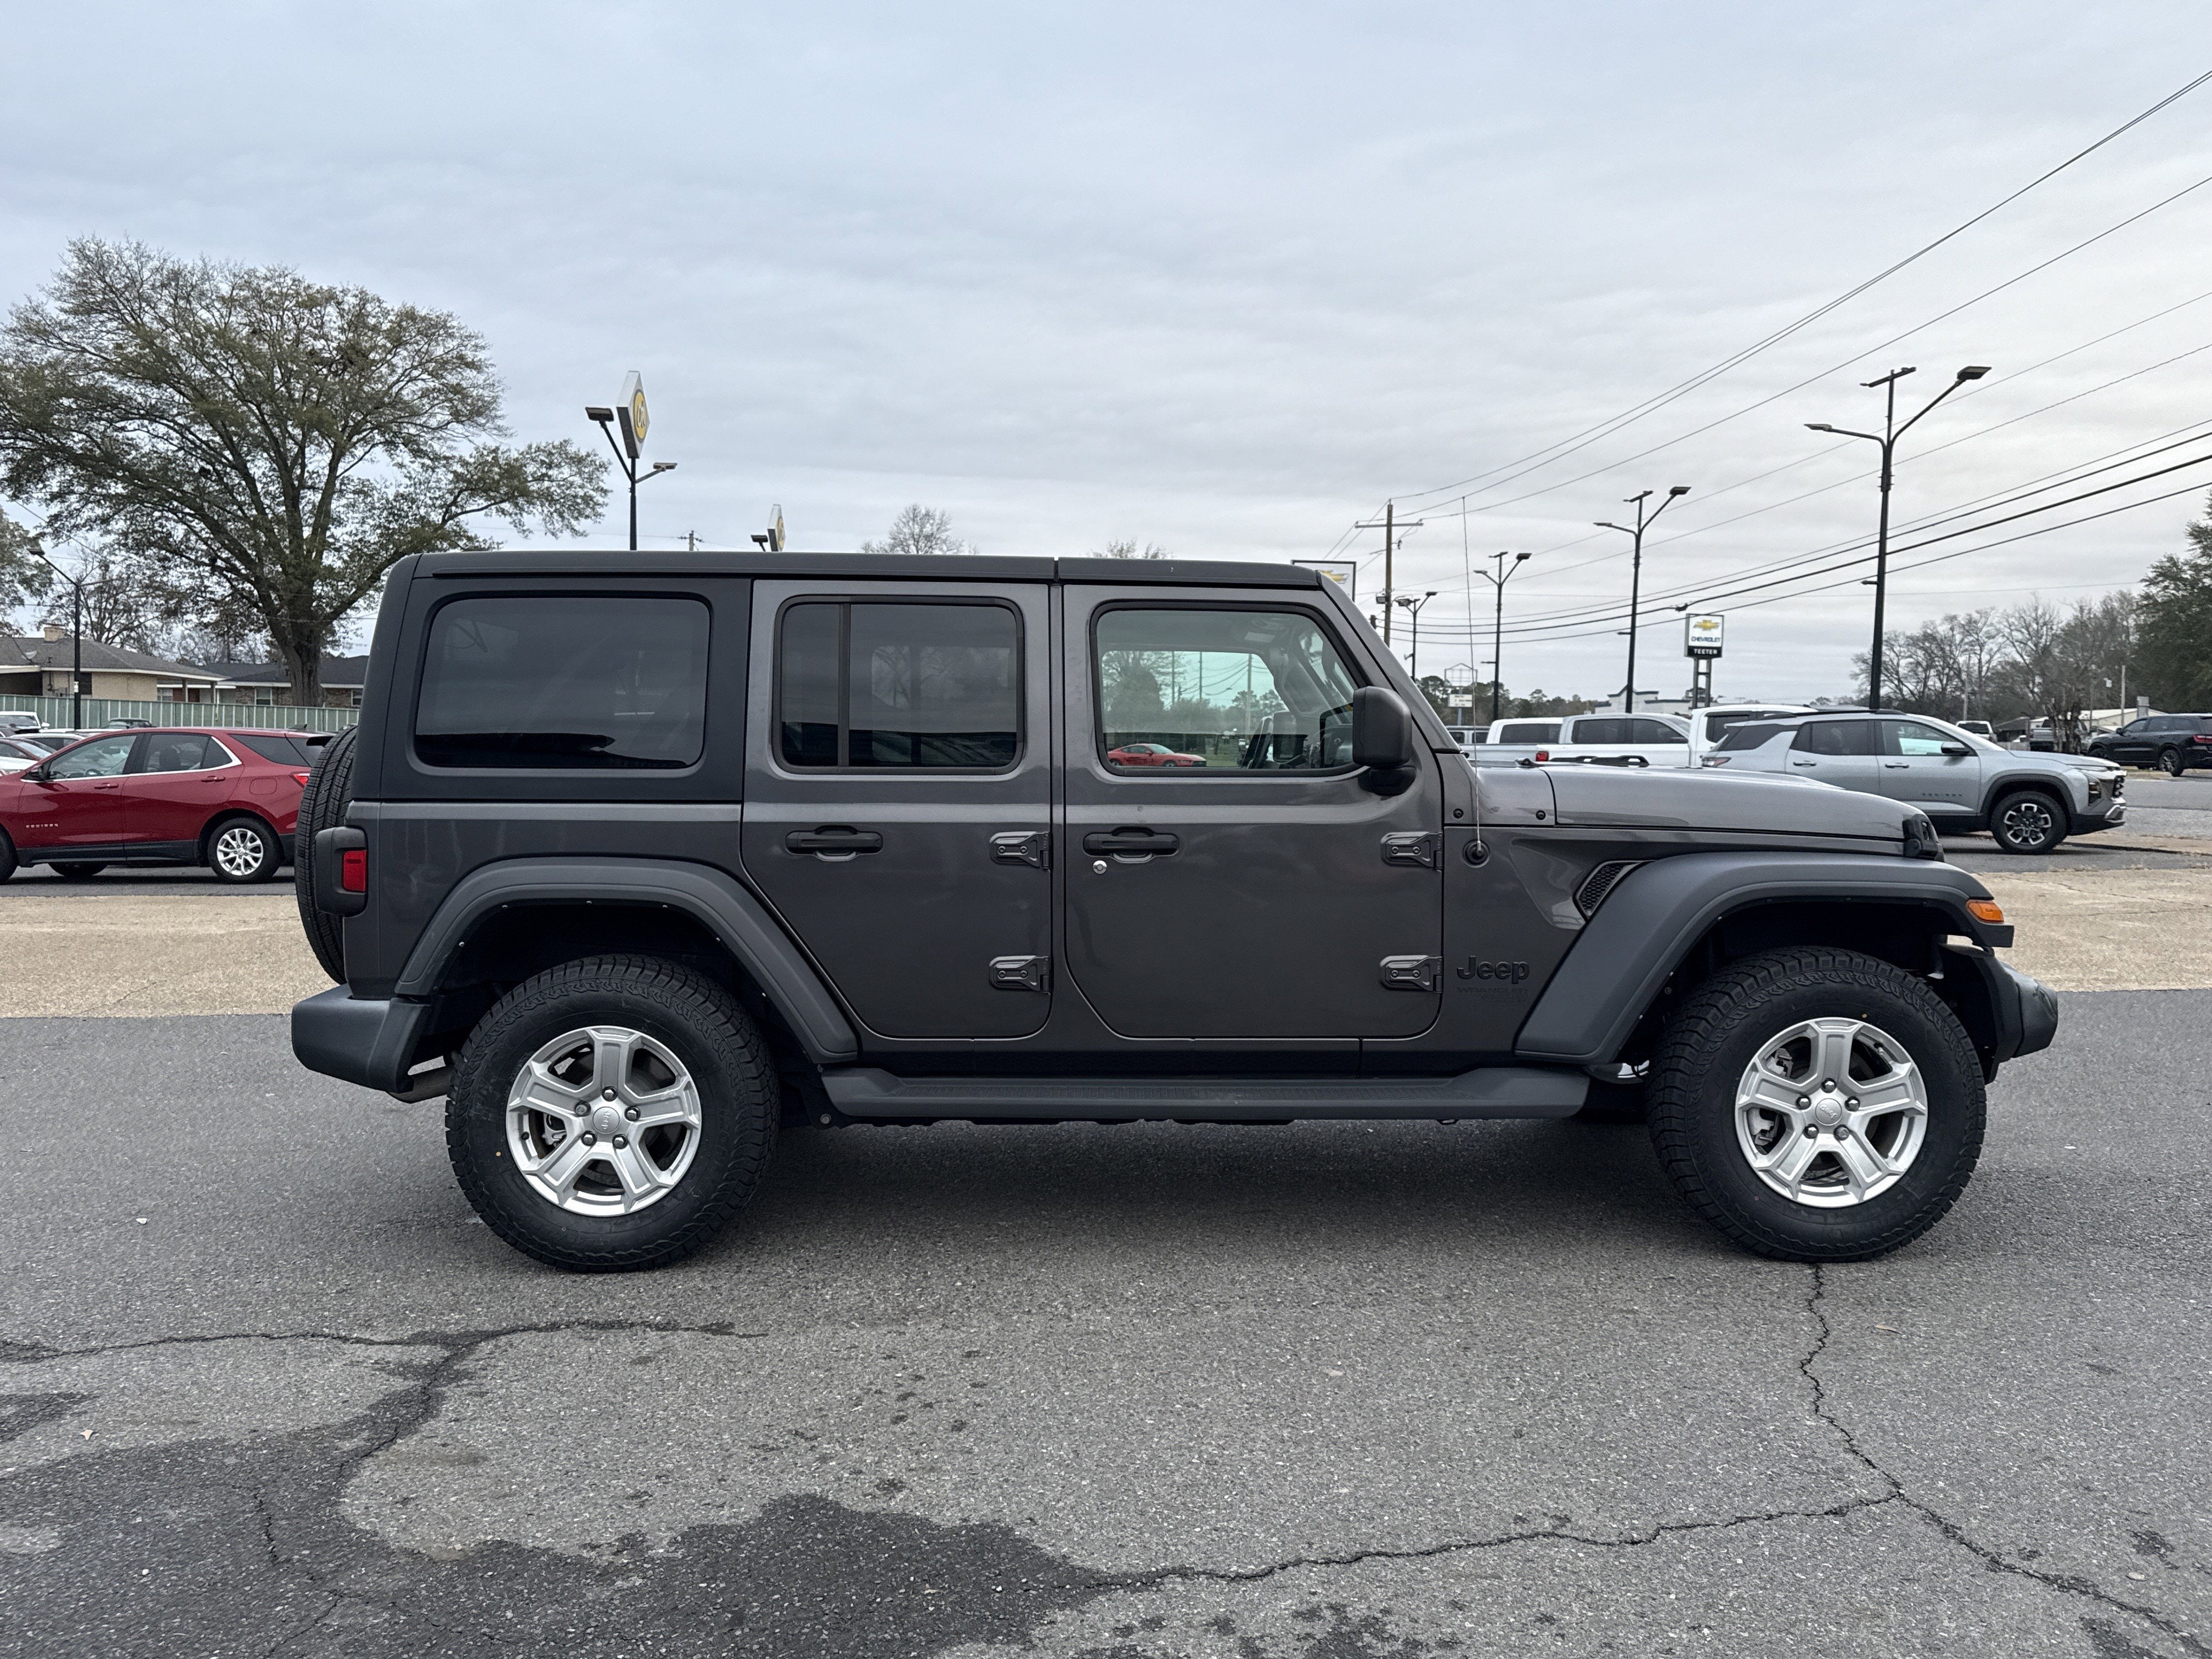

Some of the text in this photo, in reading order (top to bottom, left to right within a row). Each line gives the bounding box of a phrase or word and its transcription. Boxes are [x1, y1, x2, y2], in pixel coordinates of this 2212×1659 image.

[1457, 955, 1530, 984] Jeep
[601, 1111, 611, 1130] Jeep
[1820, 1105, 1838, 1119] Jeep
